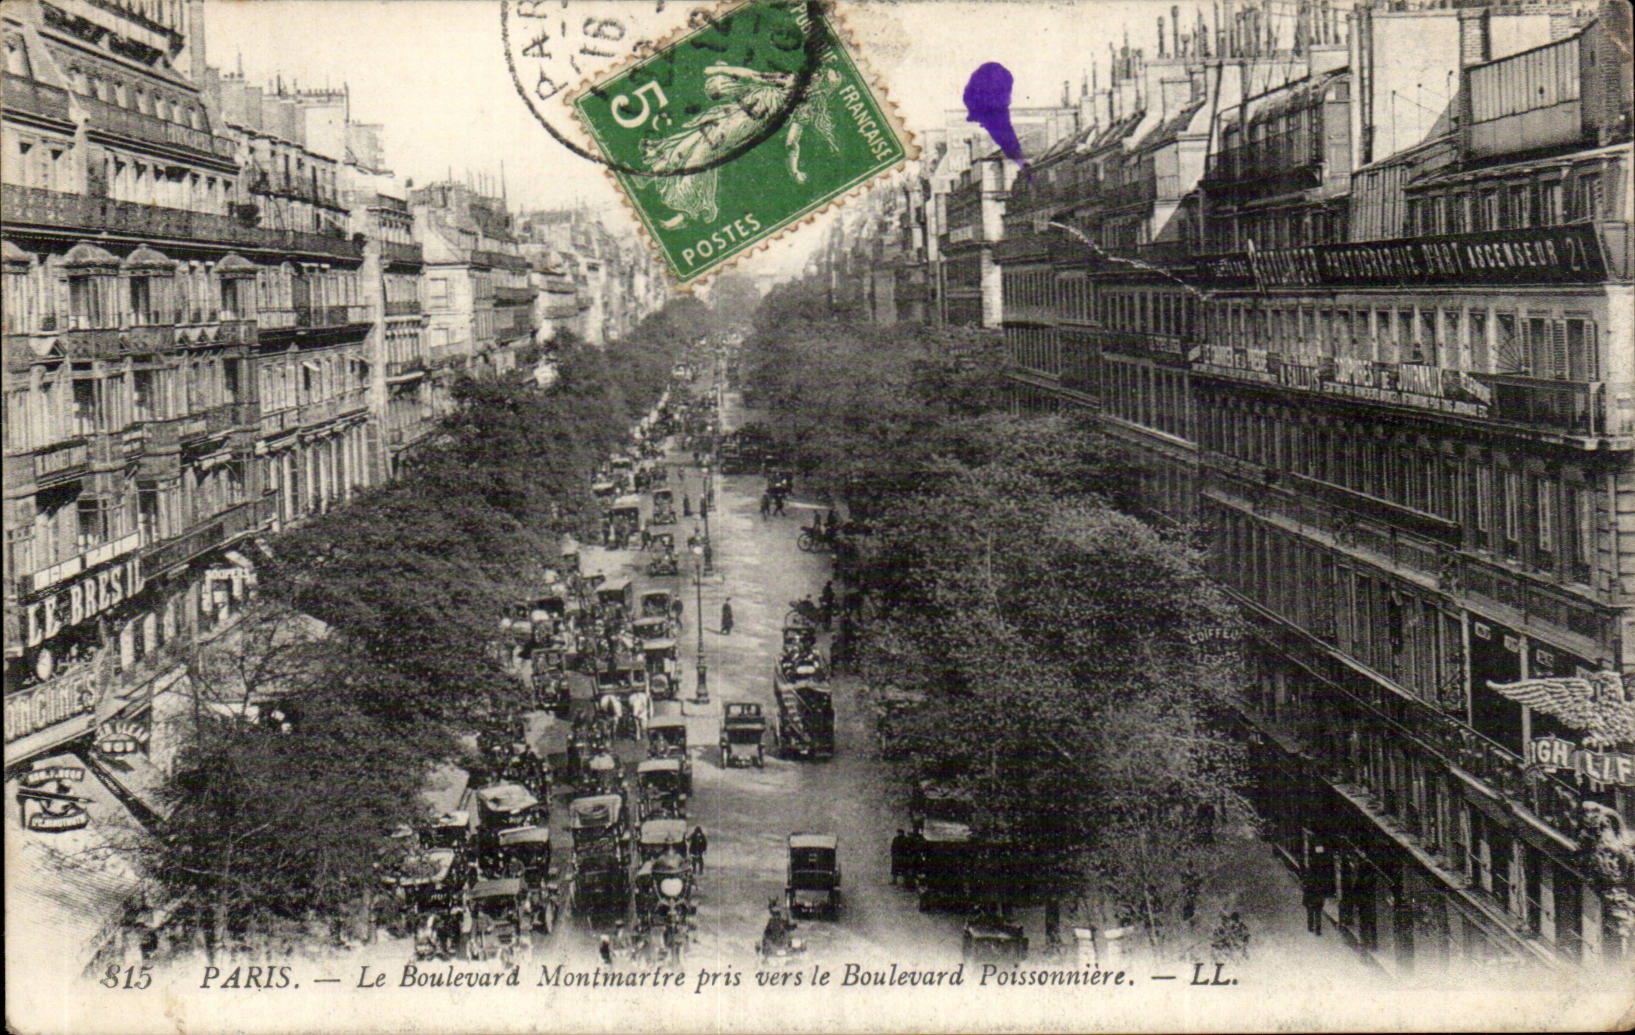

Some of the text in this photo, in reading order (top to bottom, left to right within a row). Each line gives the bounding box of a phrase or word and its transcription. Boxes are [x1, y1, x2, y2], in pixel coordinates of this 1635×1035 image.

[611, 80, 669, 129] 5
[839, 84, 893, 162] FRANÇAISE
[681, 213, 761, 267] POSTES
[1466, 239, 1559, 269] ASCENSEUR
[1565, 236, 1591, 272] 21
[27, 594, 63, 649] LE
